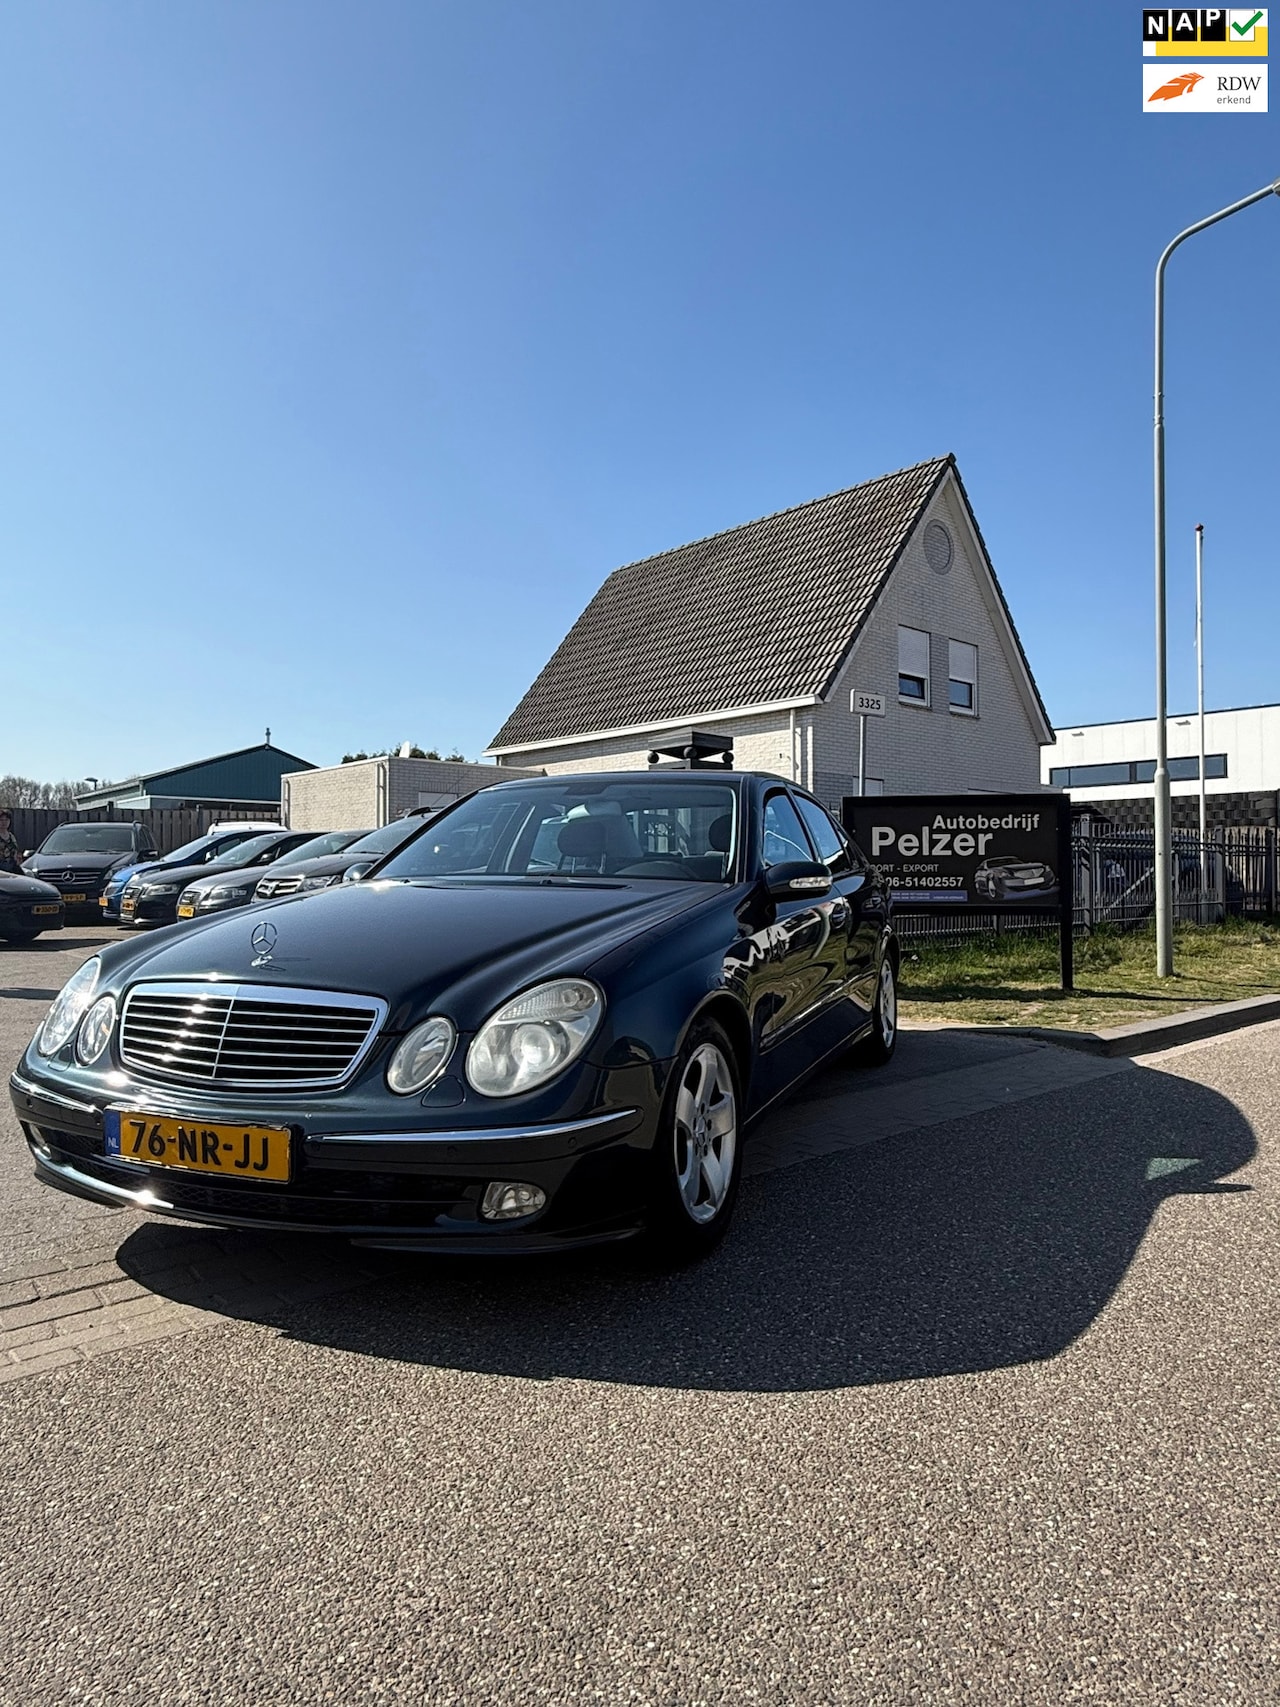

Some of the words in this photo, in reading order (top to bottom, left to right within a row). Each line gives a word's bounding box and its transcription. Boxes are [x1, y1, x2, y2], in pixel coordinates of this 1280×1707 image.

[859, 697, 881, 710] 3325
[932, 814, 1040, 832] Autobedrijf
[871, 826, 993, 857] Pelzer
[902, 863, 939, 873] EXPORT
[107, 1137, 119, 1149] NL
[129, 1119, 269, 1171] 76-NR-JJ
